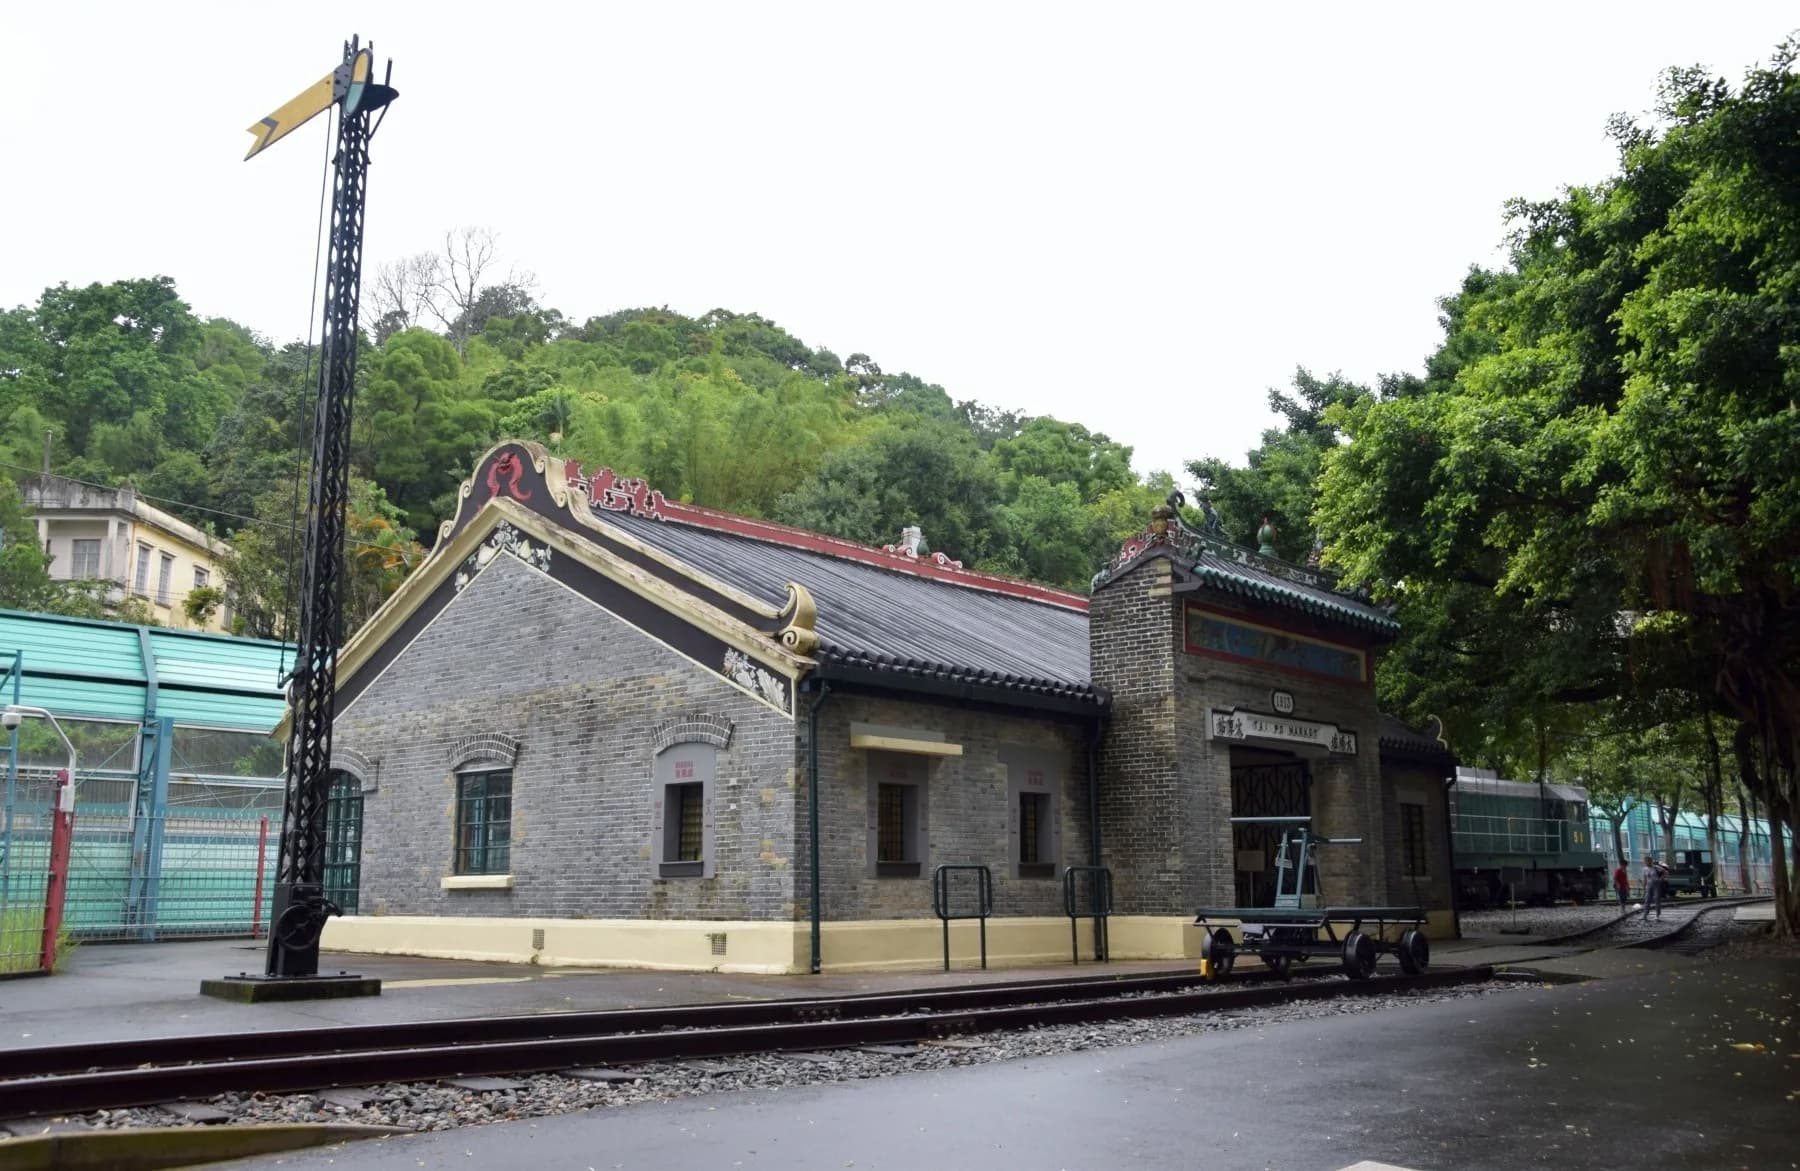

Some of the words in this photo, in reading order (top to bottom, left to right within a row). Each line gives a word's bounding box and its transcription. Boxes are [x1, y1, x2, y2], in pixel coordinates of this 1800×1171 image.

[1252, 720, 1268, 732] TAI
[1274, 724, 1284, 734] PO
[1288, 725, 1318, 738] MARKET
